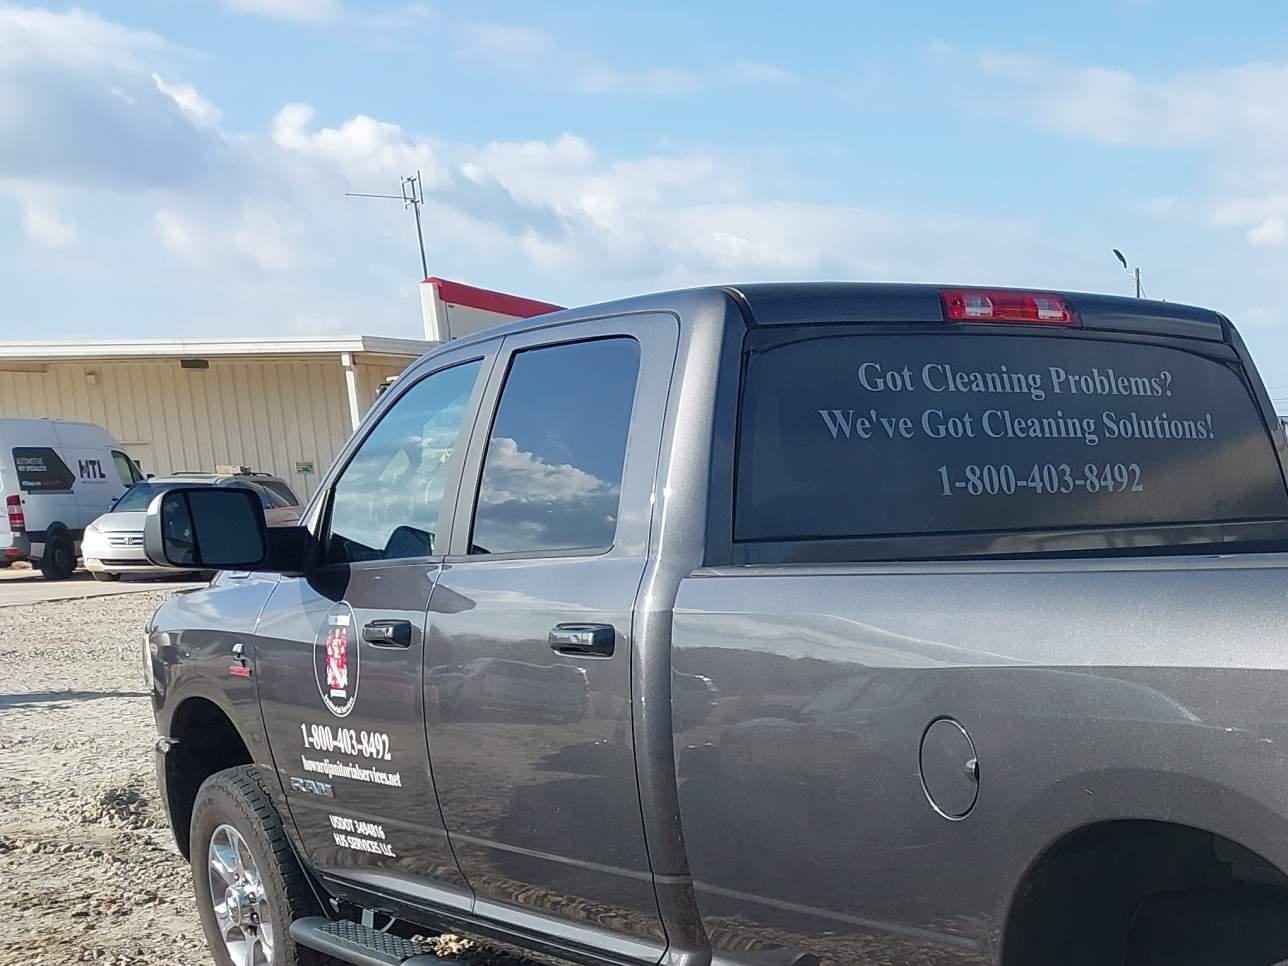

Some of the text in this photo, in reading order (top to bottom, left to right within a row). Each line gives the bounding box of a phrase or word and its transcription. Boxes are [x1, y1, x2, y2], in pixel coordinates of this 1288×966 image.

[858, 362, 1173, 401] Got Cleaning Problems?
[819, 408, 1216, 445] We've Got Cleaning Solutions!
[937, 463, 1144, 496] 1-800-403-8492
[300, 723, 391, 761] 1-800-403-8492
[290, 777, 336, 799] RAM
[329, 814, 354, 831] USDOT
[348, 836, 382, 853] SERVICES
